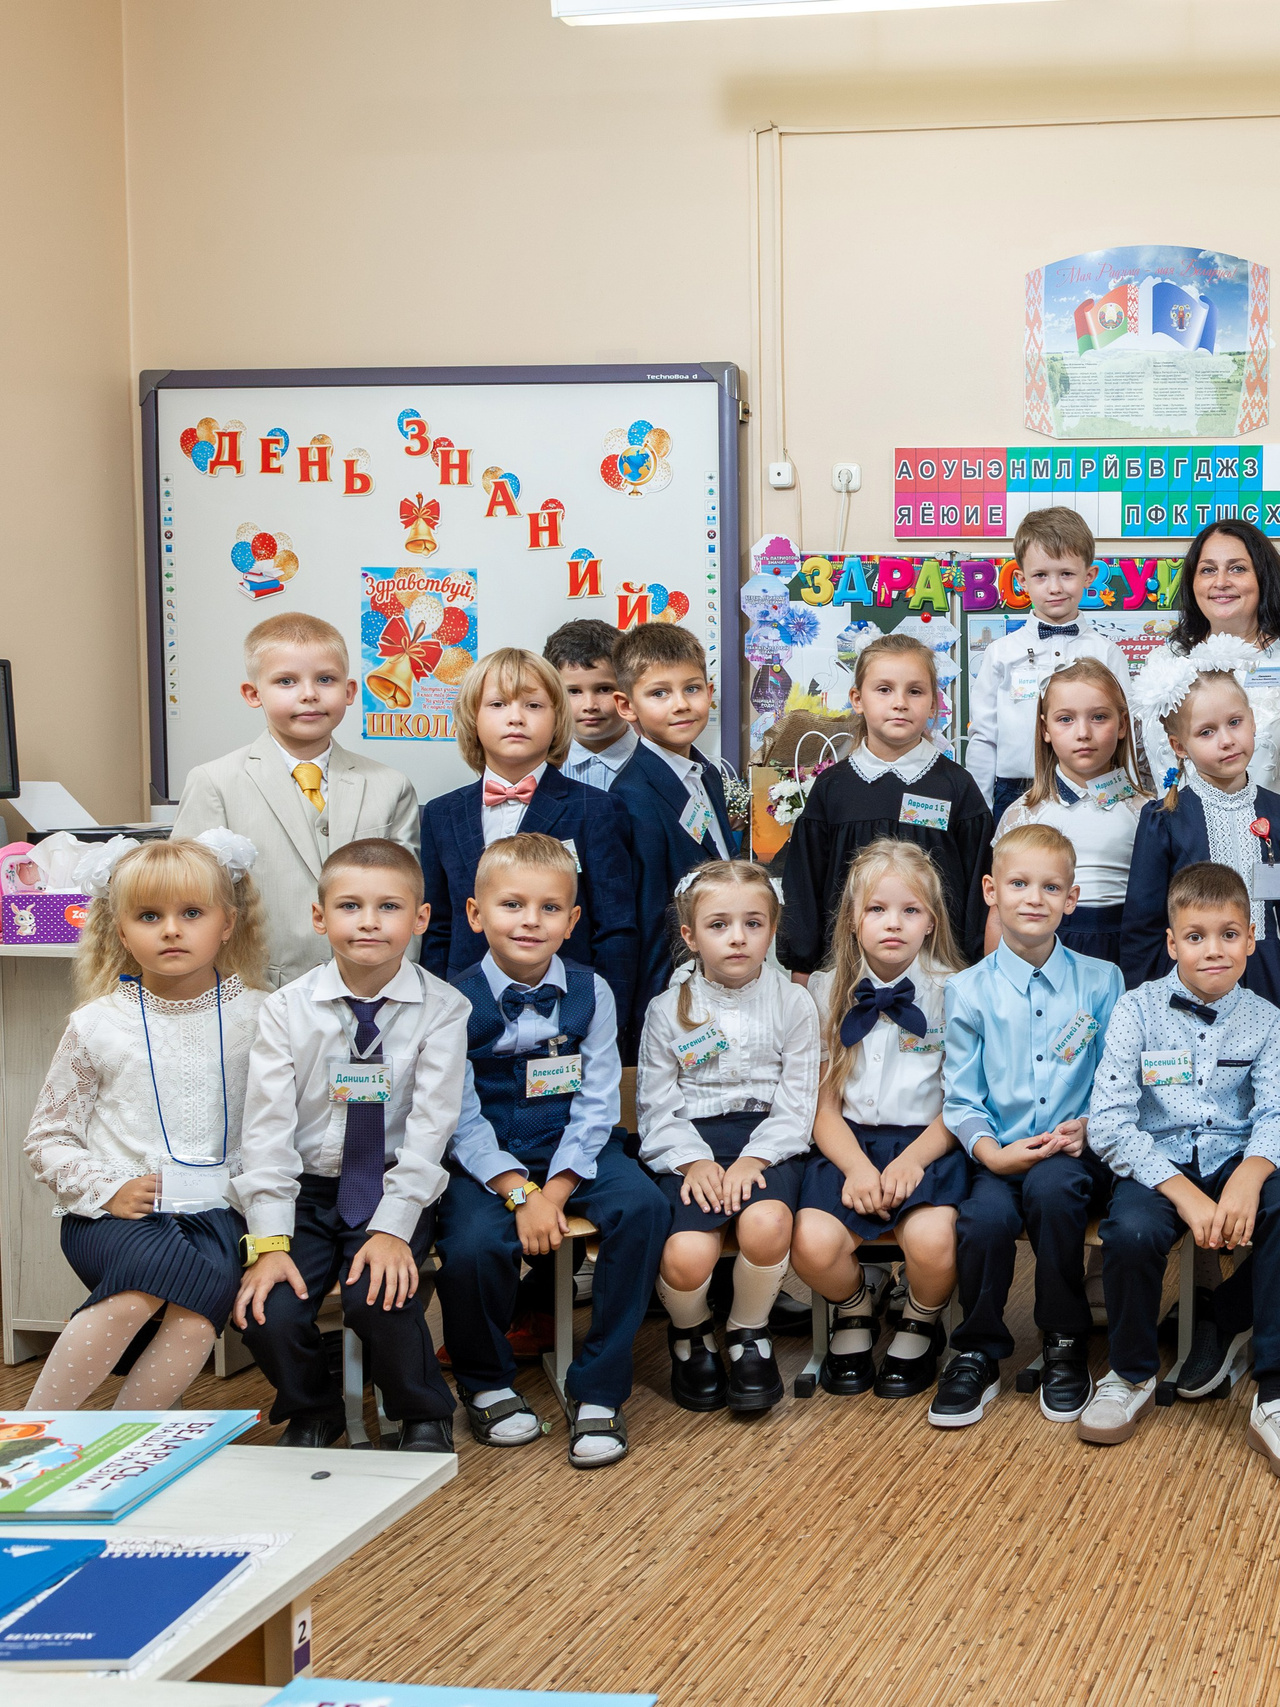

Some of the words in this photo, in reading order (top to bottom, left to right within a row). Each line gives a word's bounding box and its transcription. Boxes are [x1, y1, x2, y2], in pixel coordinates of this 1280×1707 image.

[1056, 266, 1092, 287] Мая
[1155, 266, 1174, 275] мая
[1180, 259, 1237, 284] Беларусь!
[207, 431, 373, 496] ДЕНЬ
[403, 418, 653, 630] ЗНАНИЙ
[365, 573, 474, 603] Здравствуй,
[801, 555, 1186, 611] ЗДРАВСВУЙ
[1095, 779, 1114, 790] Мария
[678, 1035, 706, 1052] Евгения
[1055, 1026, 1078, 1052] Матвей
[533, 1066, 564, 1077] Алексей
[1144, 1057, 1176, 1068] Арсений
[336, 1074, 369, 1083] Даниил
[133, 1422, 181, 1449] НАША
[114, 1422, 216, 1481] БЕЛАРУСЬ
[68, 1451, 139, 1492] РАДЗІМА
[298, 1620, 307, 1644] 2
